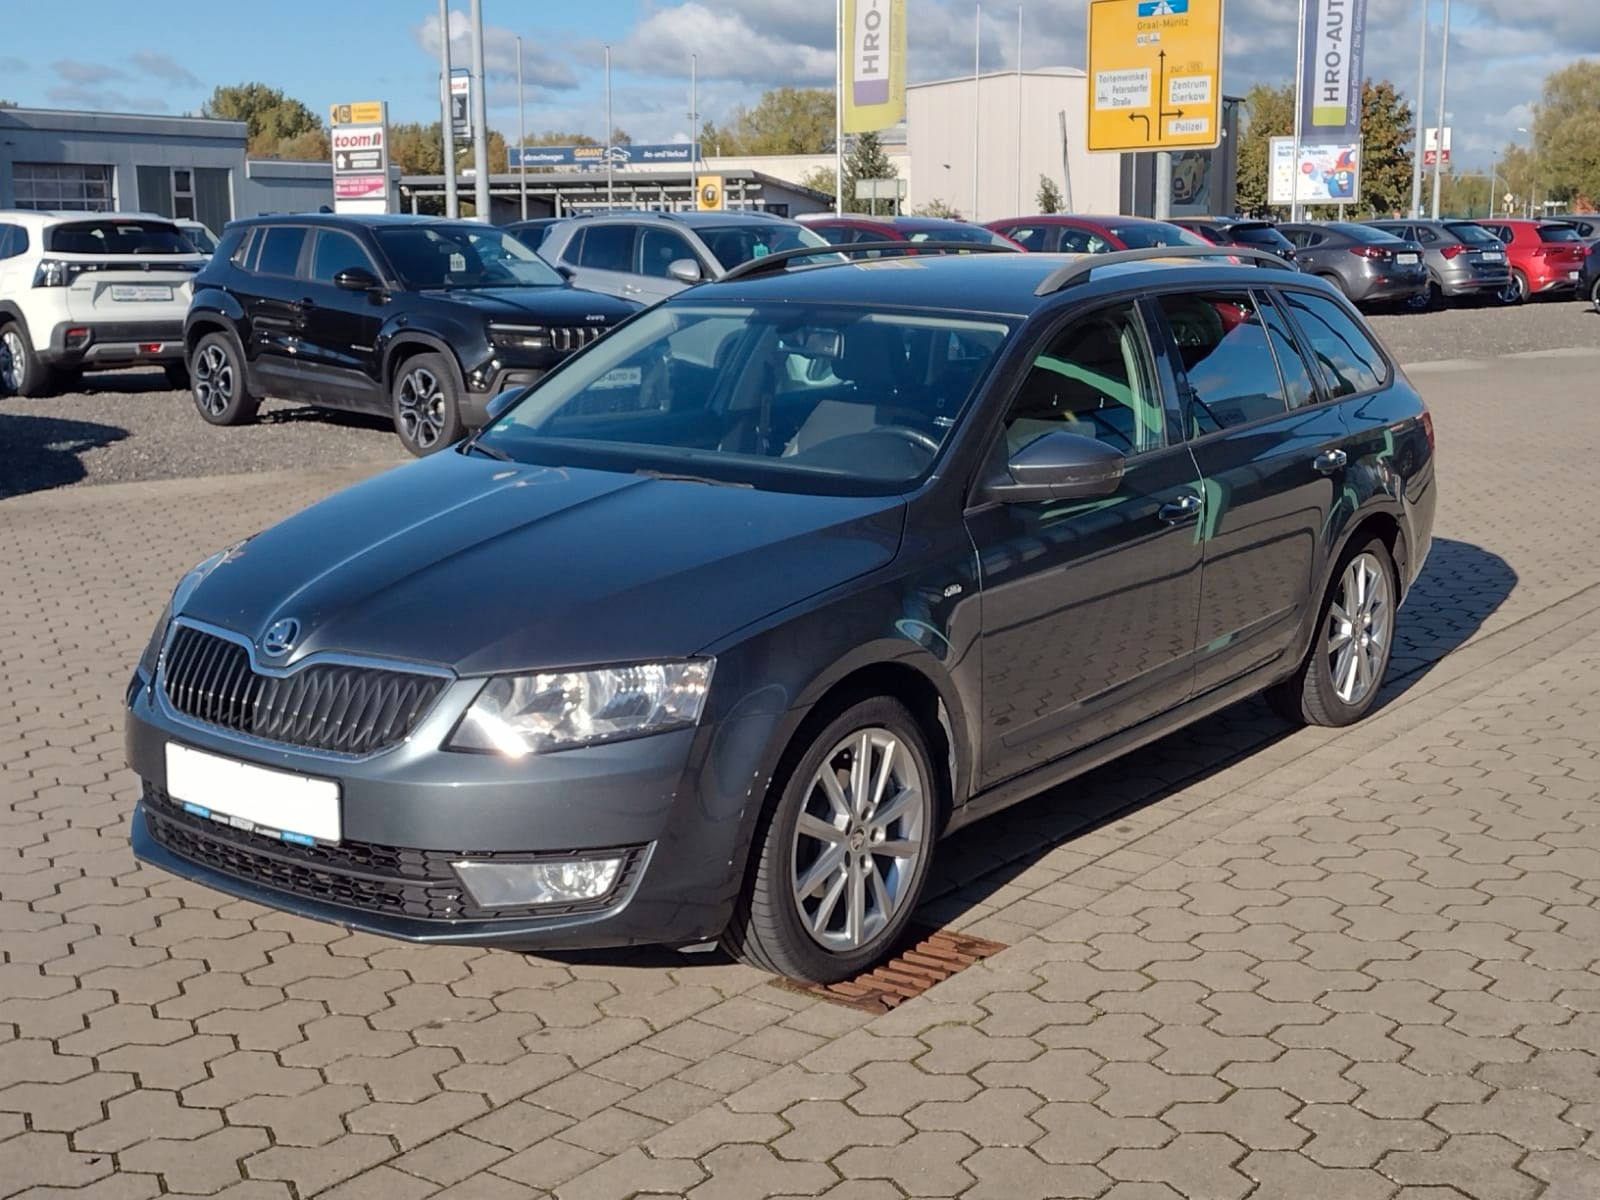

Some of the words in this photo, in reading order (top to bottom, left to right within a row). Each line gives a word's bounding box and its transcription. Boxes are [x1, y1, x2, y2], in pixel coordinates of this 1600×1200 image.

[862, 1, 881, 74] HRO-
[1172, 80, 1207, 90] Zentrum
[1171, 93, 1205, 102] Dierkow
[1175, 121, 1202, 131] Polizei
[334, 133, 370, 147] toom
